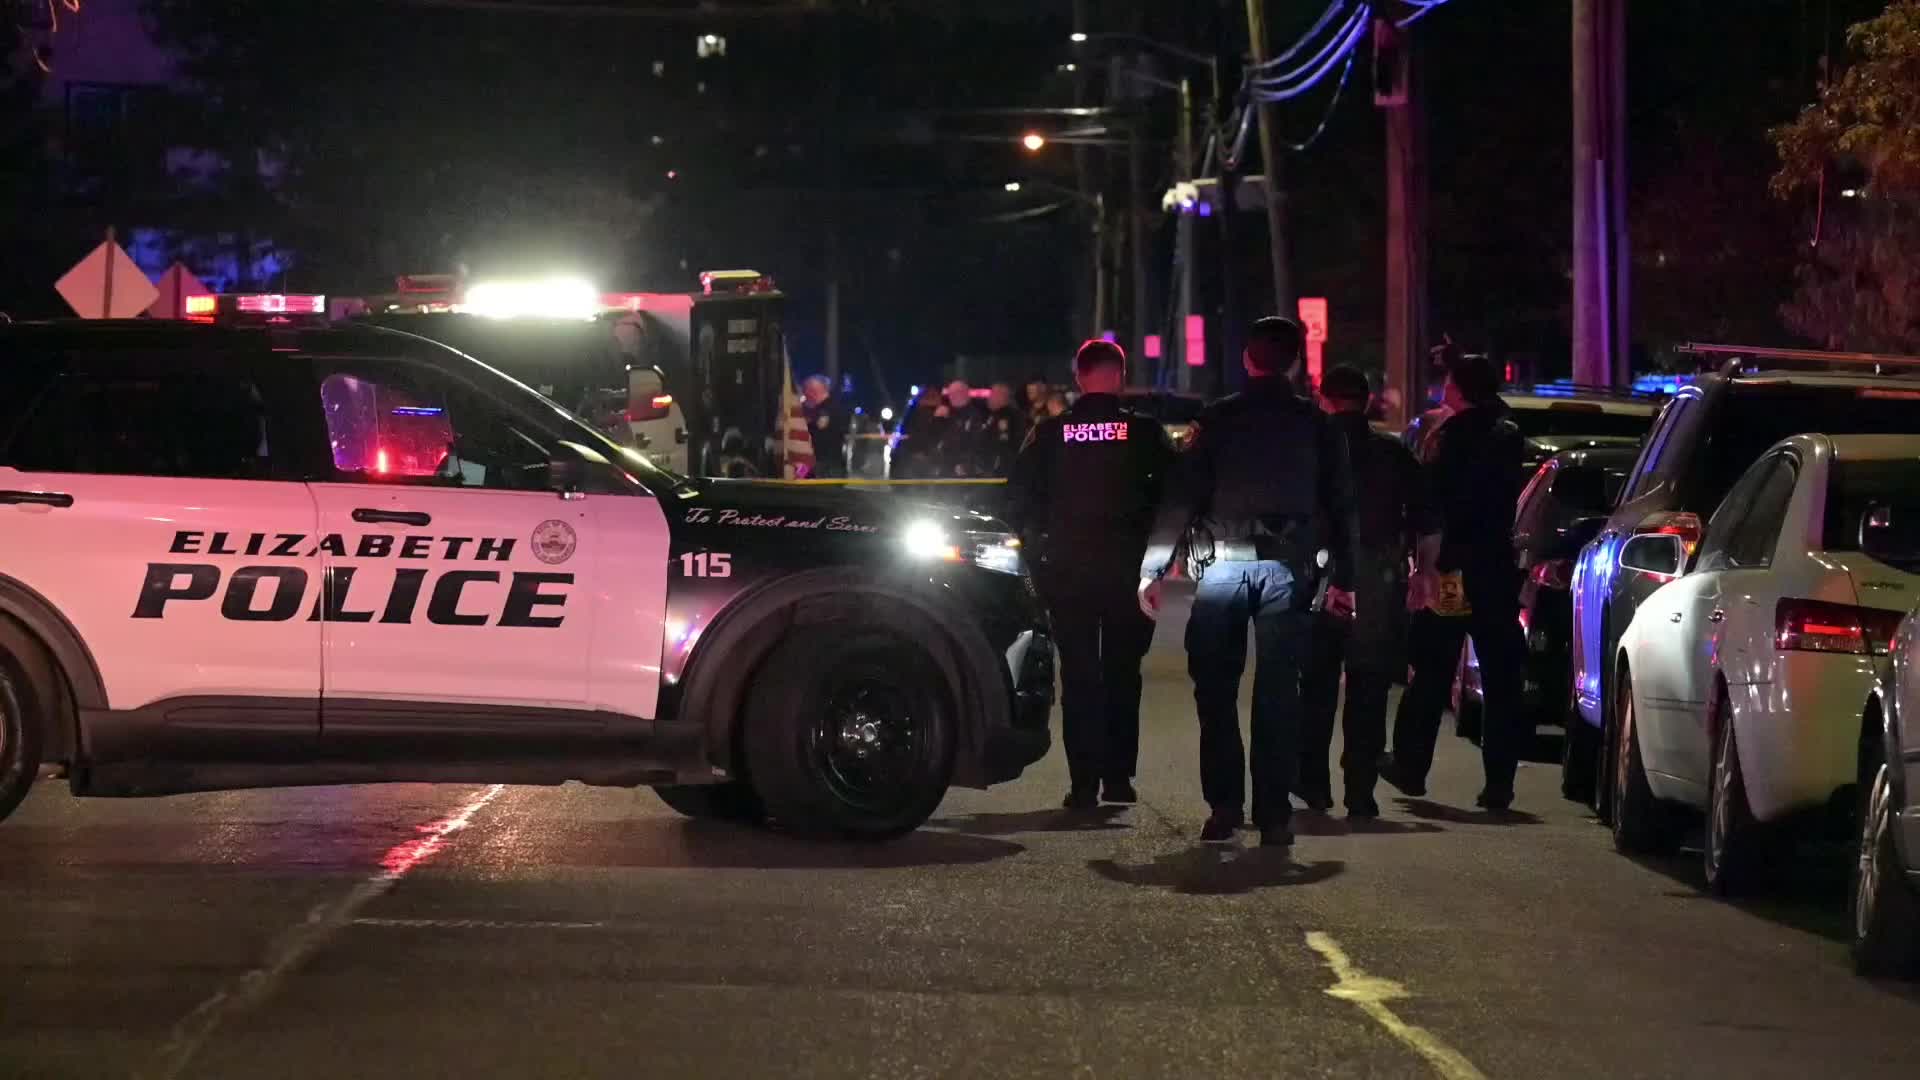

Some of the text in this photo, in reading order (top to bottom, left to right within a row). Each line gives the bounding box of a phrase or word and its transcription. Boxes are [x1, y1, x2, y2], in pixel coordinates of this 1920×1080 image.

[1063, 422, 1128, 432] ELIZABETH
[1063, 430, 1128, 442] POLICE
[685, 507, 712, 524] To
[717, 509, 785, 528] Protect
[784, 516, 825, 529] and
[168, 531, 517, 560] ELIZABETH
[680, 552, 732, 578] 115
[130, 563, 575, 628] POLICE
